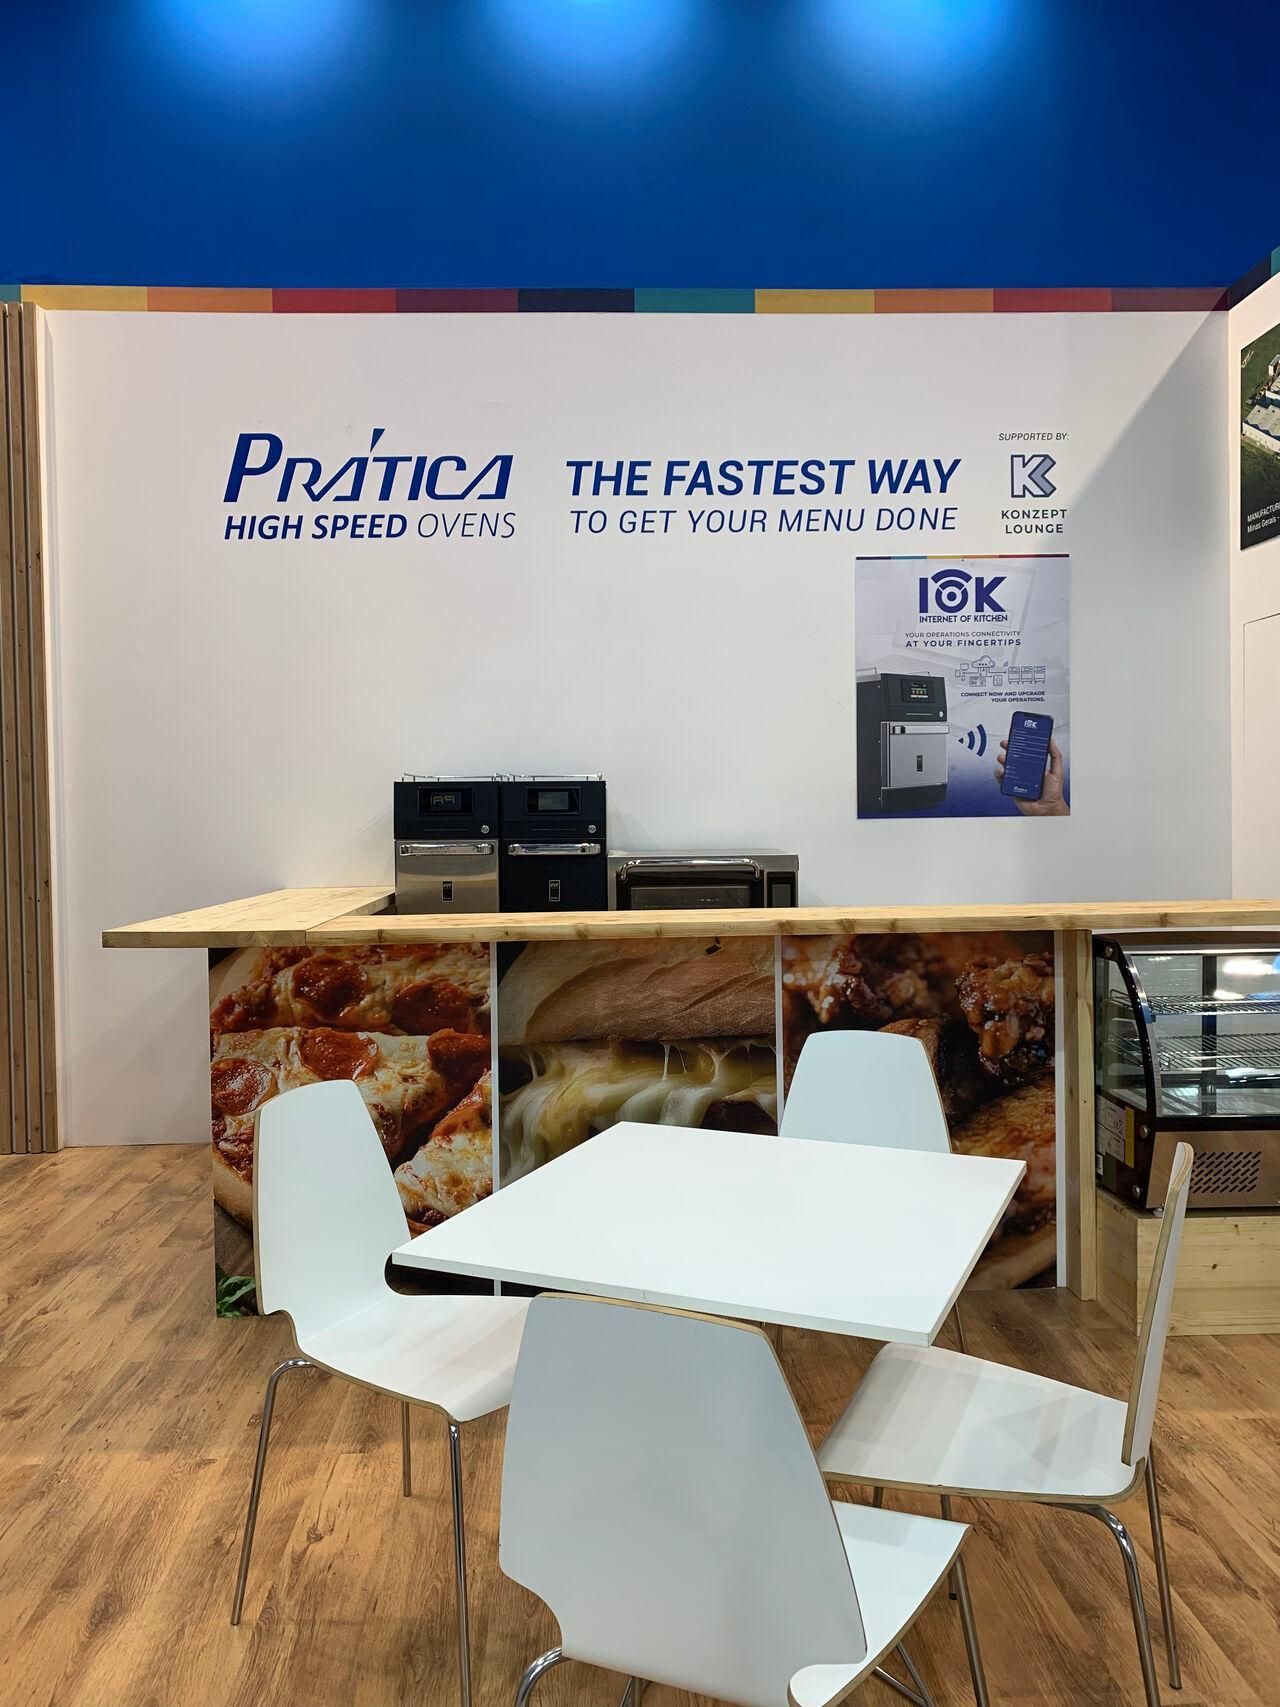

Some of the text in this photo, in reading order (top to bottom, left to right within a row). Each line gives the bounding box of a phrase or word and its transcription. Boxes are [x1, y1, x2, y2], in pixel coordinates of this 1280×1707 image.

[998, 432, 1070, 441] SUPPORTED BY:
[566, 458, 962, 496] THE FASTEST WAY
[570, 506, 959, 534] TO GET YOUR MENU DONE
[1001, 508, 1068, 520] KONZEPT
[224, 512, 517, 540] HIGH SPEED OVENS
[1005, 523, 1064, 535] LOUNGE
[919, 614, 1008, 623] INTERNET OF KITCHEN
[957, 638, 1022, 647] FINGERTIPS
